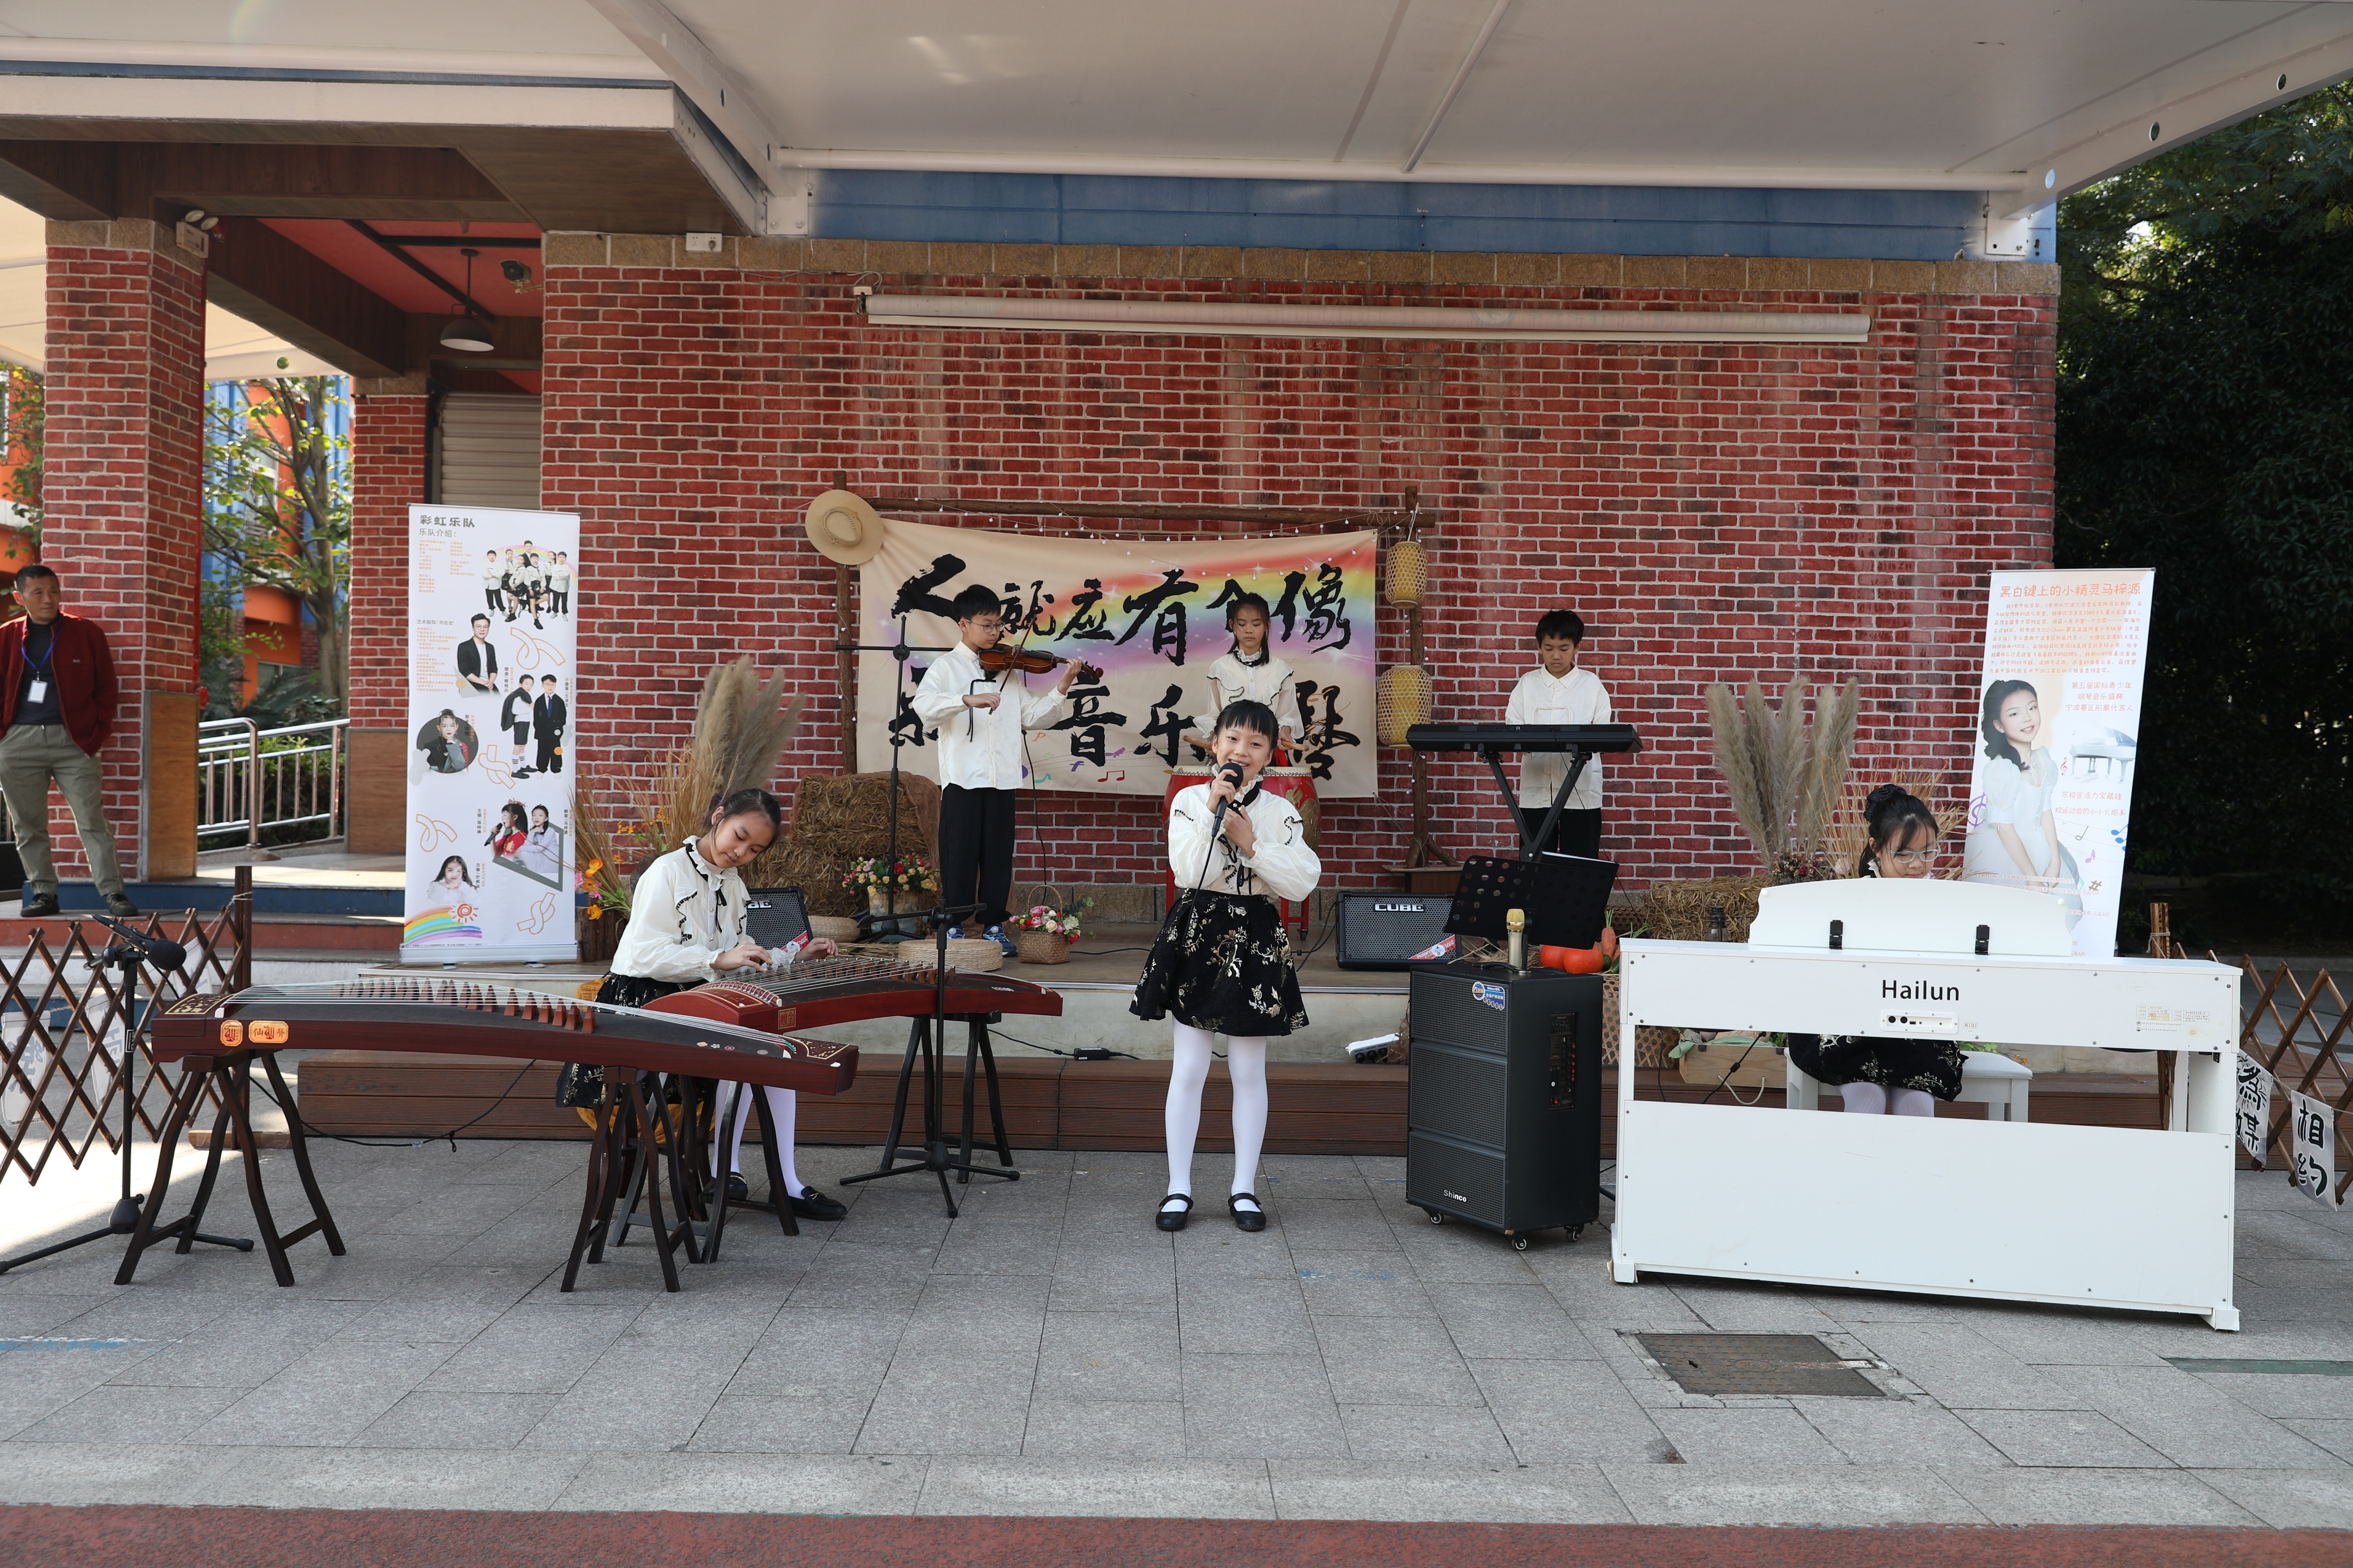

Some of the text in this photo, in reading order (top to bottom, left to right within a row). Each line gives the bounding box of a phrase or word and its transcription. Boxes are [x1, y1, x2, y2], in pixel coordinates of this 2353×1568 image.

[420, 515, 475, 528] 彩虹乐队
[1999, 583, 2141, 598] 黑白键上的小精灵马梓源
[2071, 681, 2132, 689] 第五届国际青少年
[2065, 703, 2134, 712] 宁波赛区形象代言人
[2061, 791, 2122, 800] 东校区活力宝藏娃
[2055, 807, 2126, 816] 校运动会的小小火炬手
[748, 900, 772, 909] BE
[1882, 979, 1959, 1001] Hailun
[2297, 1096, 2328, 1197] 相约
[1444, 1190, 1467, 1202] Shinco
